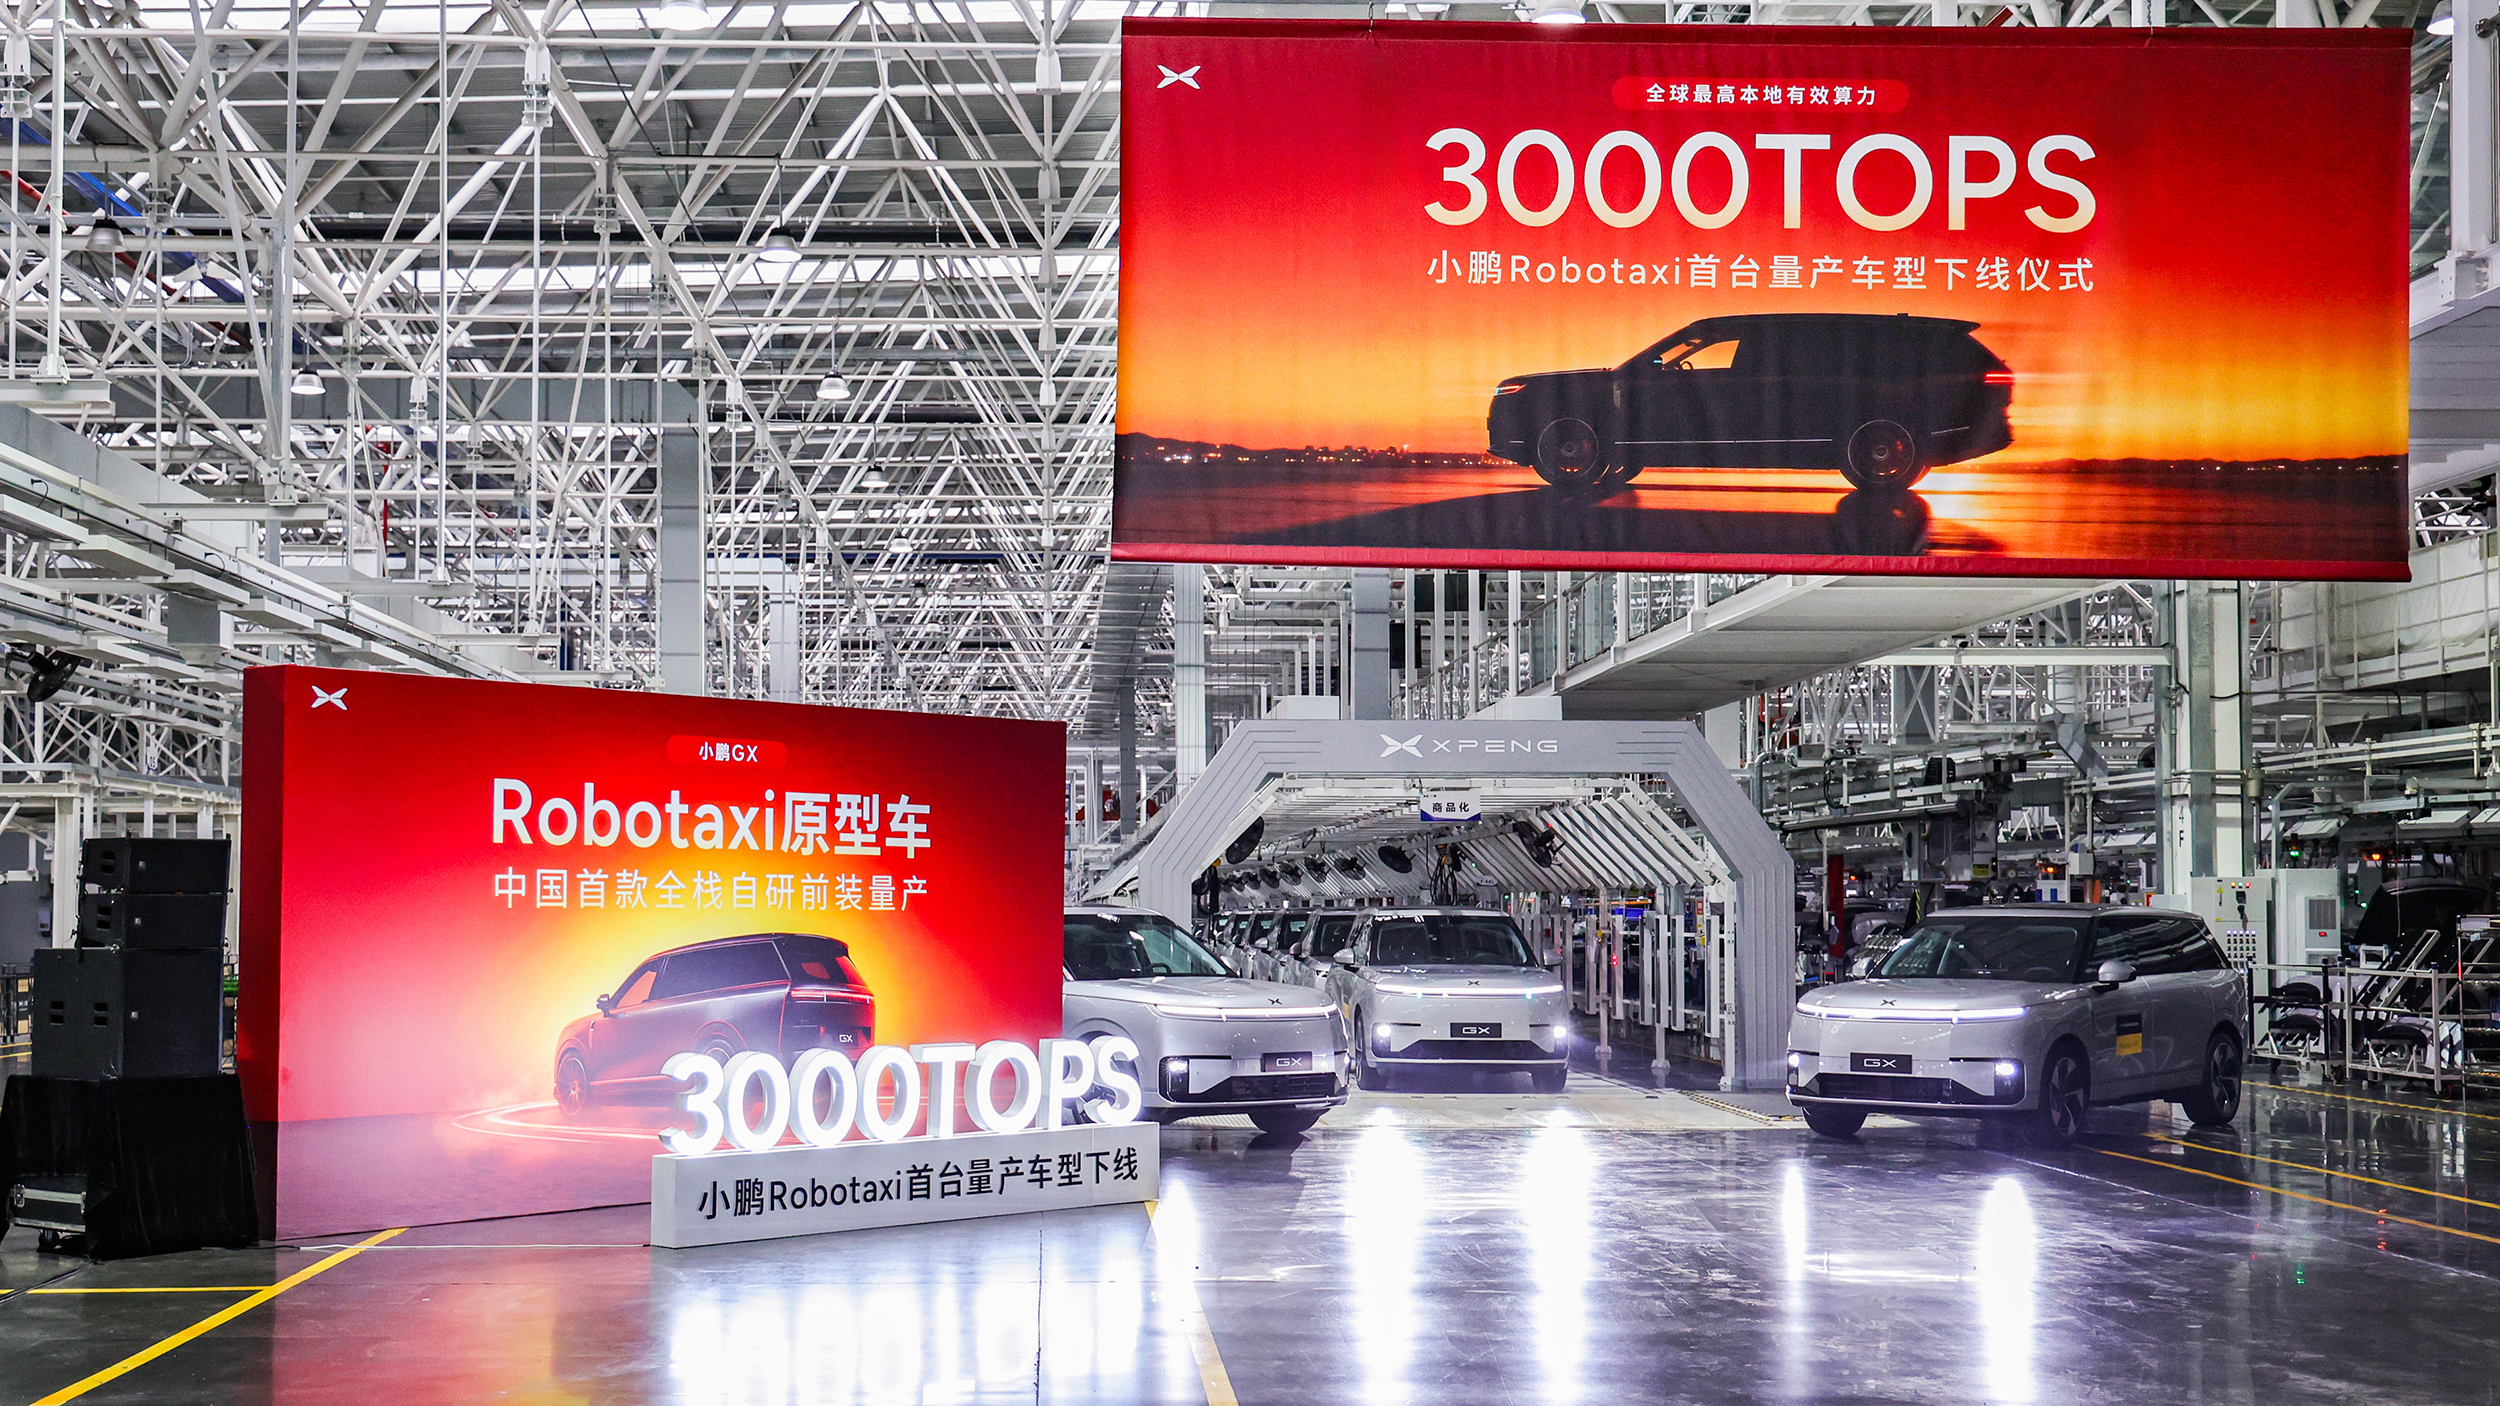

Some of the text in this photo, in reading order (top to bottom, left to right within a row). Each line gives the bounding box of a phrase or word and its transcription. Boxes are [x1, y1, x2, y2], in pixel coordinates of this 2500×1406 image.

[1646, 82, 1878, 107] 全球最高本地有效算力
[1423, 127, 2098, 234] 3000TOPS
[1427, 248, 2095, 293] 小鹏Robotaxi首台量产车型下线仪式
[698, 741, 759, 763] 小鹏GX
[1432, 739, 1558, 753] XPENG
[492, 777, 932, 860] Robotaxi原型车
[1432, 801, 1470, 813] 商品化
[493, 866, 928, 912] 中国首款全栈自研前装量产
[838, 1034, 854, 1043] GX
[1461, 1026, 1491, 1035] GX
[1275, 1056, 1303, 1067] GX
[1863, 1058, 1897, 1069] GX
[657, 1035, 1142, 1156] 3000TOPS
[698, 1147, 1139, 1220] 小鹏Robotaxi首台量产车型下线
